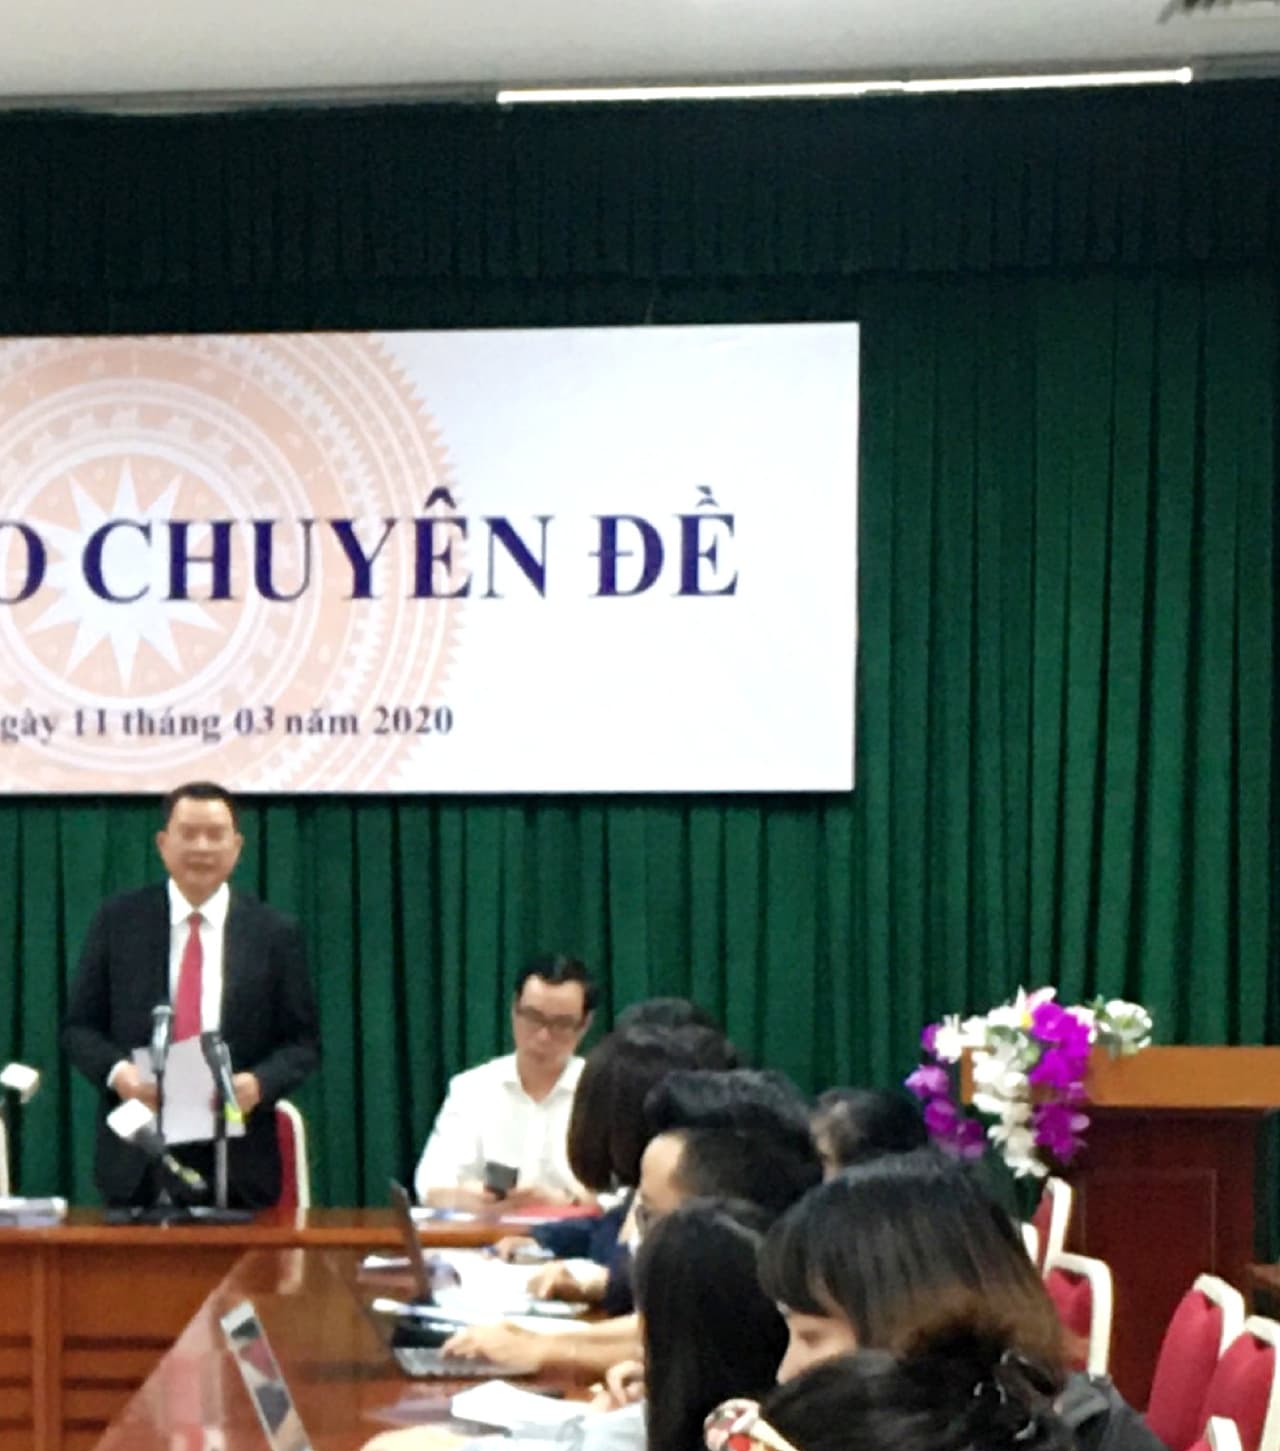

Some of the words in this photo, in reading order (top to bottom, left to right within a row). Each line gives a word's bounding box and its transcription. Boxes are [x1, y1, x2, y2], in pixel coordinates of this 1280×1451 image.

[81, 485, 555, 605] CHUYÊN
[588, 484, 739, 599] ĐỀ
[74, 708, 108, 736] 11
[122, 706, 222, 743] tháng
[234, 705, 276, 735] 03
[284, 707, 359, 735] năm
[372, 705, 454, 735] 2020
